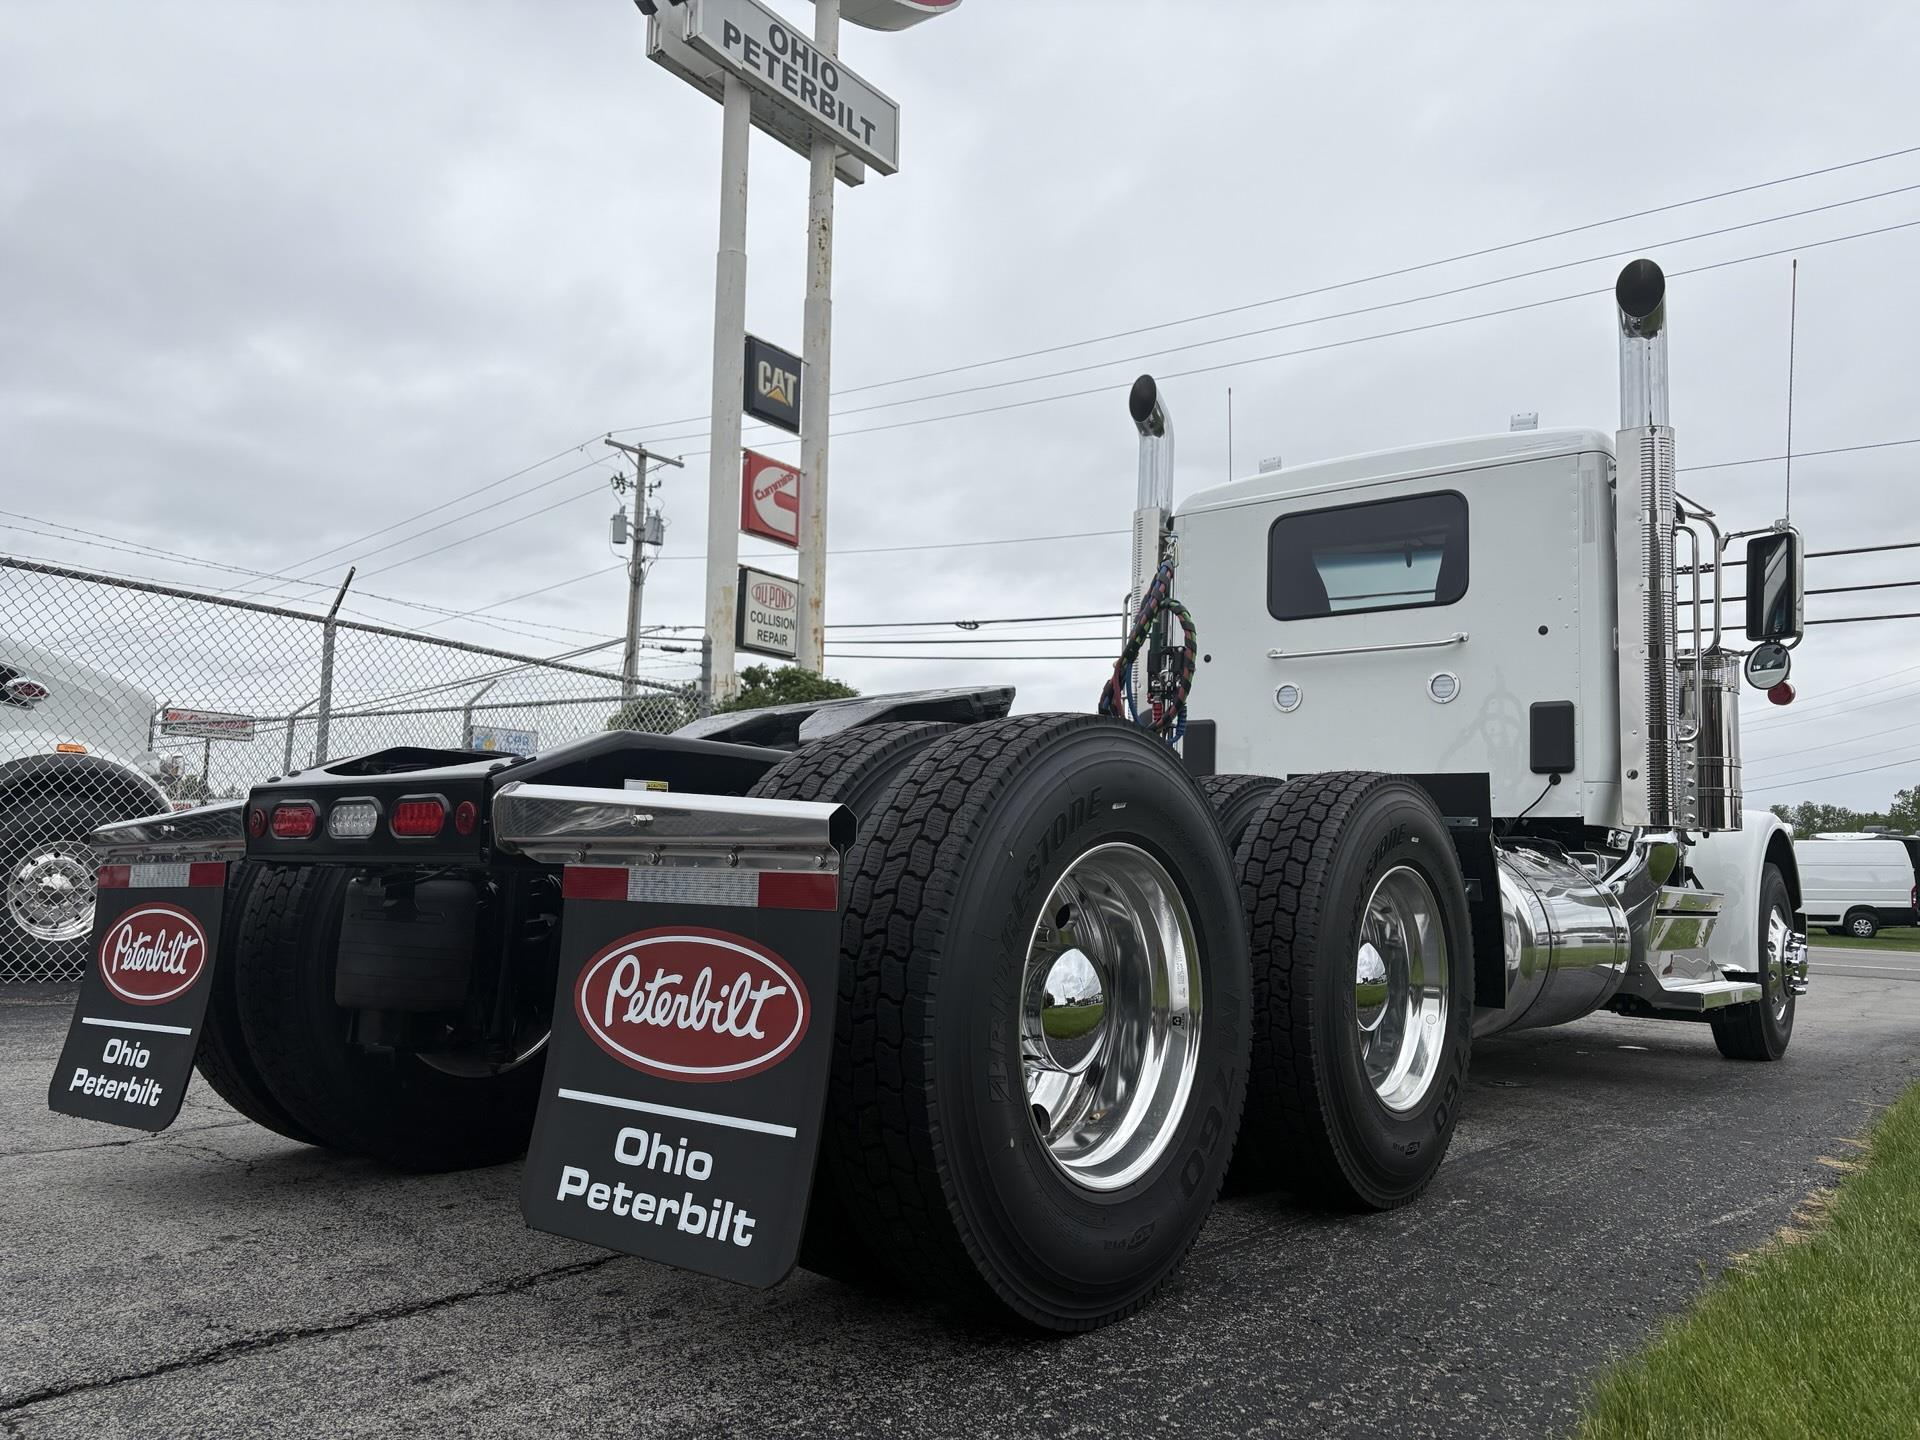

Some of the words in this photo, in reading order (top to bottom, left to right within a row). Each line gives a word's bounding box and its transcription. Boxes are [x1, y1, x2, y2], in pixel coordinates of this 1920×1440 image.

[723, 19, 876, 146] PETERBILT
[768, 24, 839, 92] OHIO
[758, 360, 797, 408] CAT
[755, 473, 794, 500] Cummins
[750, 610, 795, 630] COLLISION
[757, 629, 788, 646] REPAIR
[111, 923, 199, 975] Peterbilt
[604, 954, 787, 1040] Peterbilt
[102, 1038, 150, 1069] Ohio
[68, 1067, 163, 1107] Peterbilt
[614, 1126, 714, 1181] Ohio
[556, 1164, 756, 1248] Peterbilt
